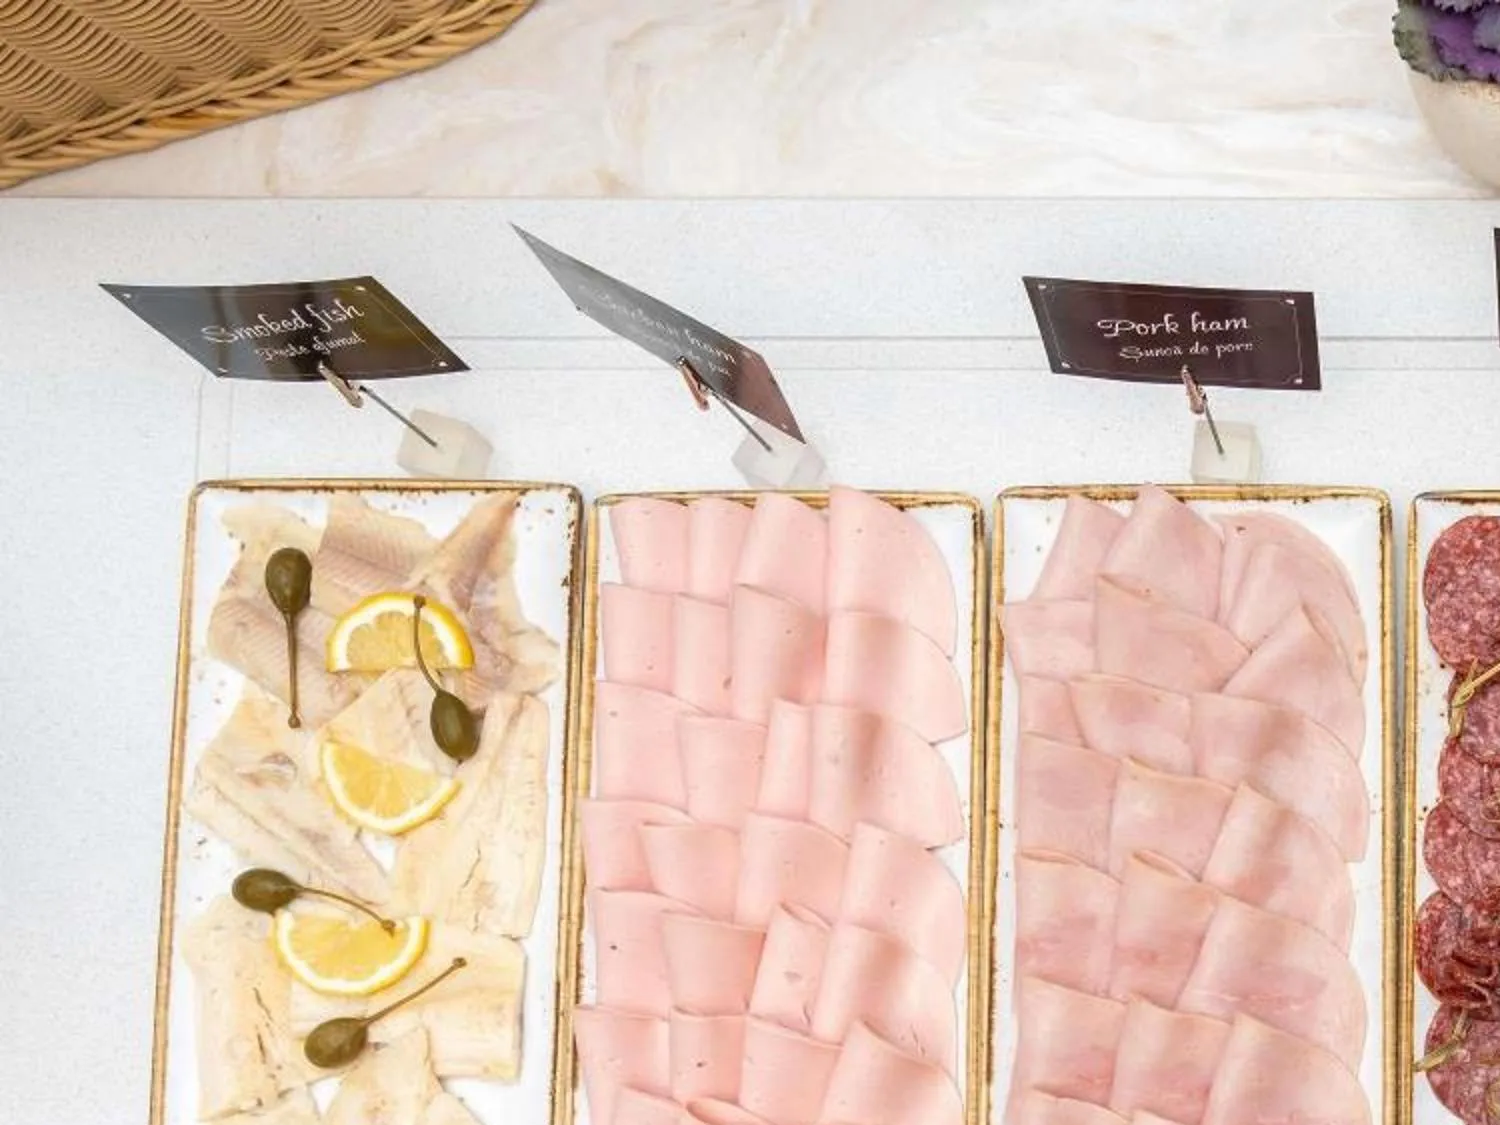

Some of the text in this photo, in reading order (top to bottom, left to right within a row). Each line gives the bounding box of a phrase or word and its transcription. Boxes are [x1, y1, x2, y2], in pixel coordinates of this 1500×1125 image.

[201, 297, 365, 343] Smoked fish
[1097, 310, 1251, 338] Pork ham
[1189, 341, 1209, 355] de
